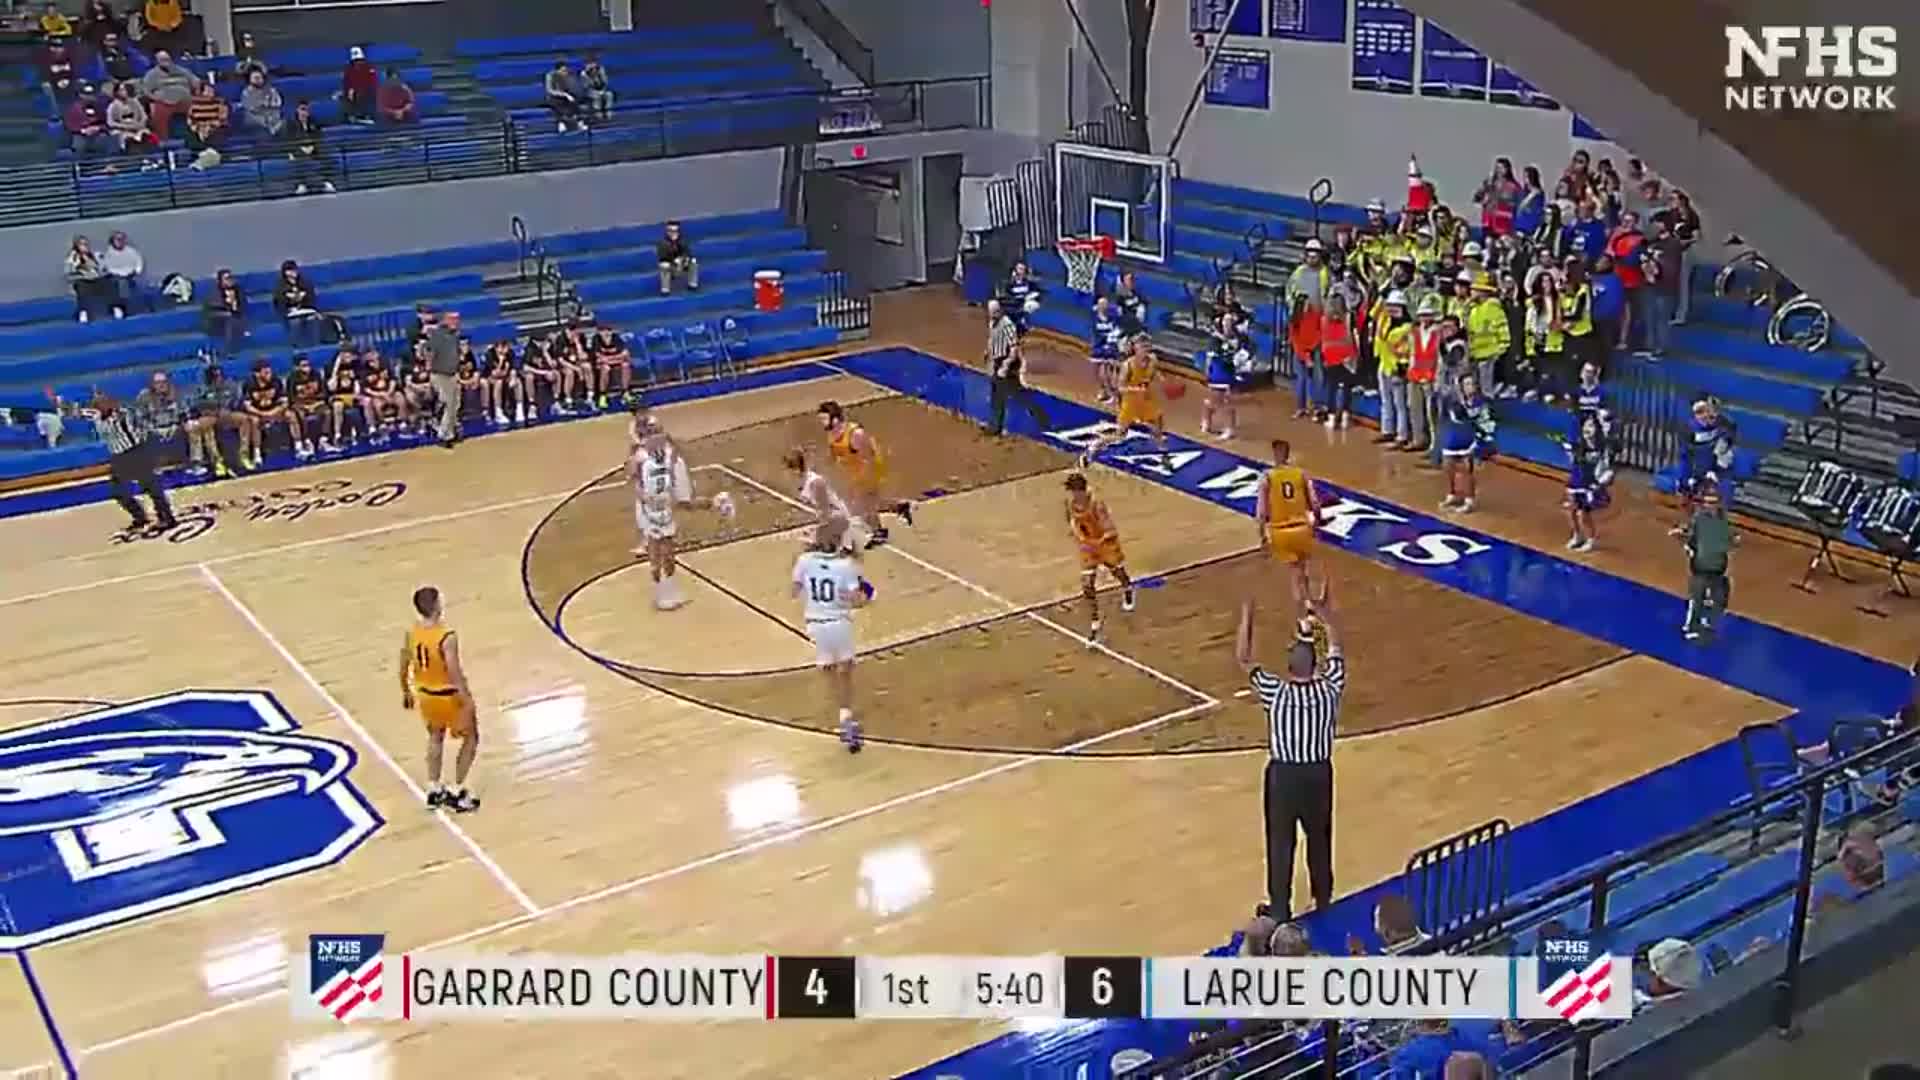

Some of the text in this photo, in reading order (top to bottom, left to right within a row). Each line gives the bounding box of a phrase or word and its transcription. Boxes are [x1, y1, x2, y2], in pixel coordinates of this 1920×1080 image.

[1281, 481, 1295, 500] 0
[809, 577, 835, 603] 10
[416, 642, 430, 669] 11
